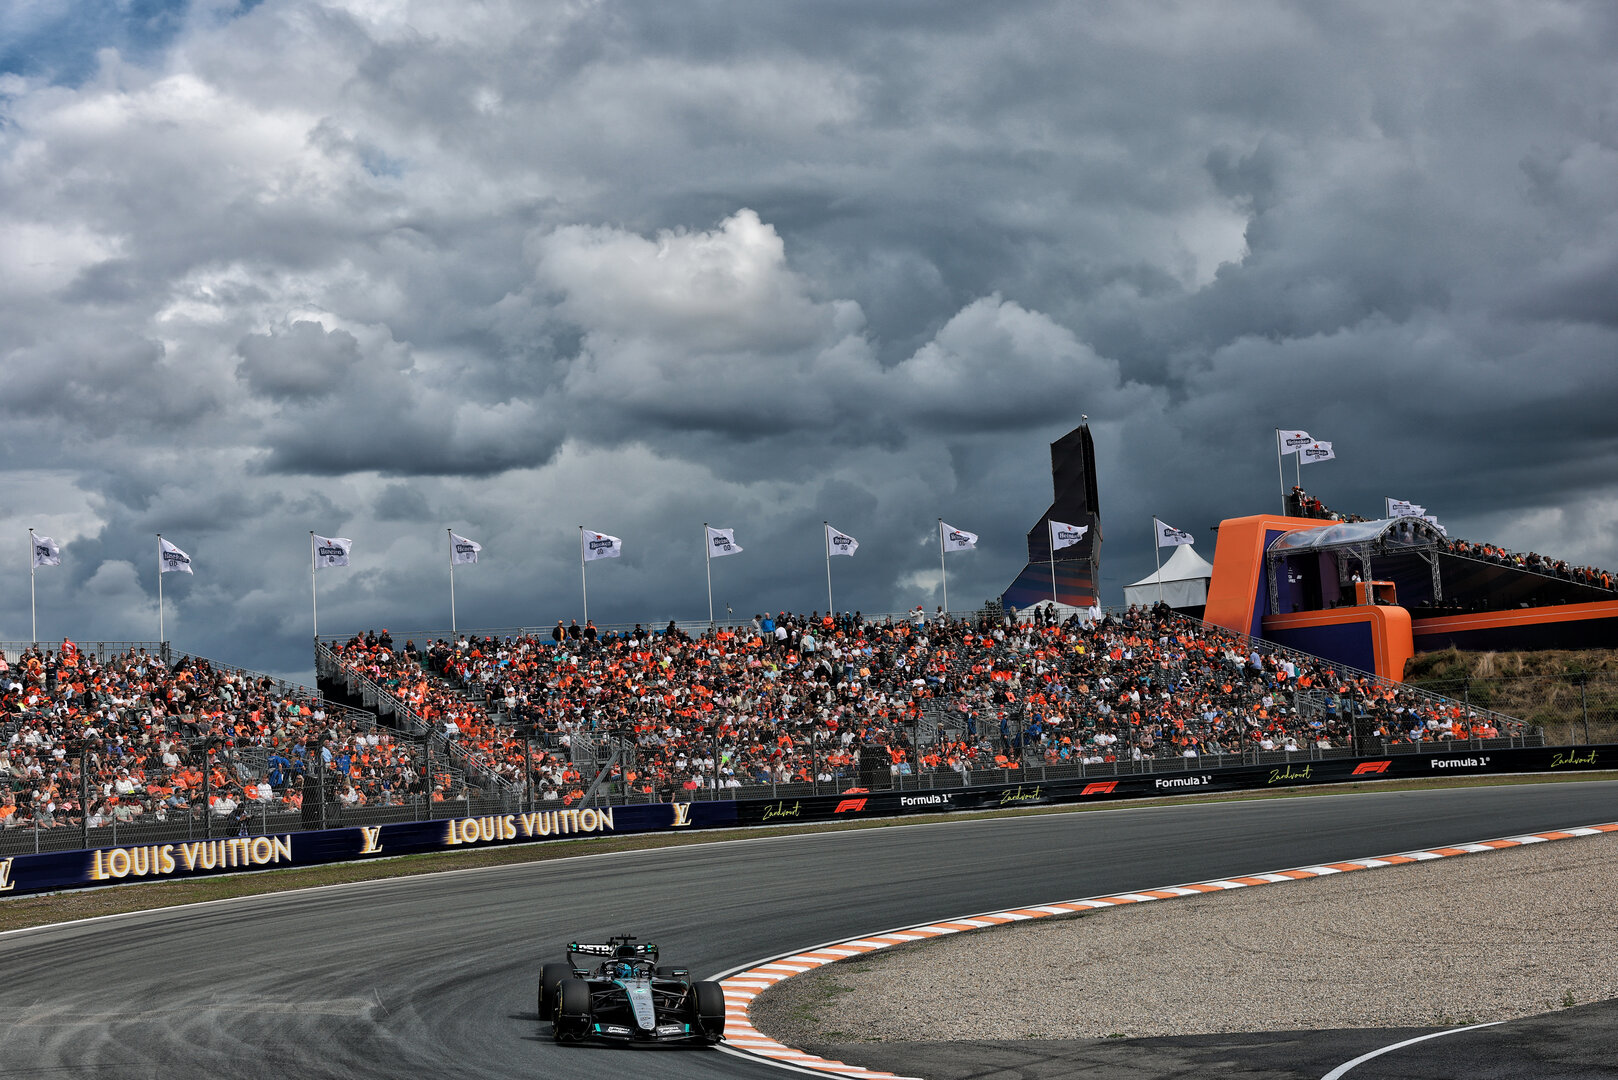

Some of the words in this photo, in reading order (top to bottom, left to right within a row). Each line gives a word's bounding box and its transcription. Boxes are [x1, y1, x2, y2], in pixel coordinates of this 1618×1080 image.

[1431, 757, 1478, 768] Formula
[1550, 749, 1599, 768] Zandvoort
[1155, 777, 1201, 788] Formula
[1268, 764, 1313, 784] Zandvoort
[900, 795, 942, 806] Formula
[448, 814, 517, 845] LOUIS
[521, 807, 614, 838] VUITTON
[95, 844, 176, 880] LOUIS
[182, 834, 293, 871] VUITTON
